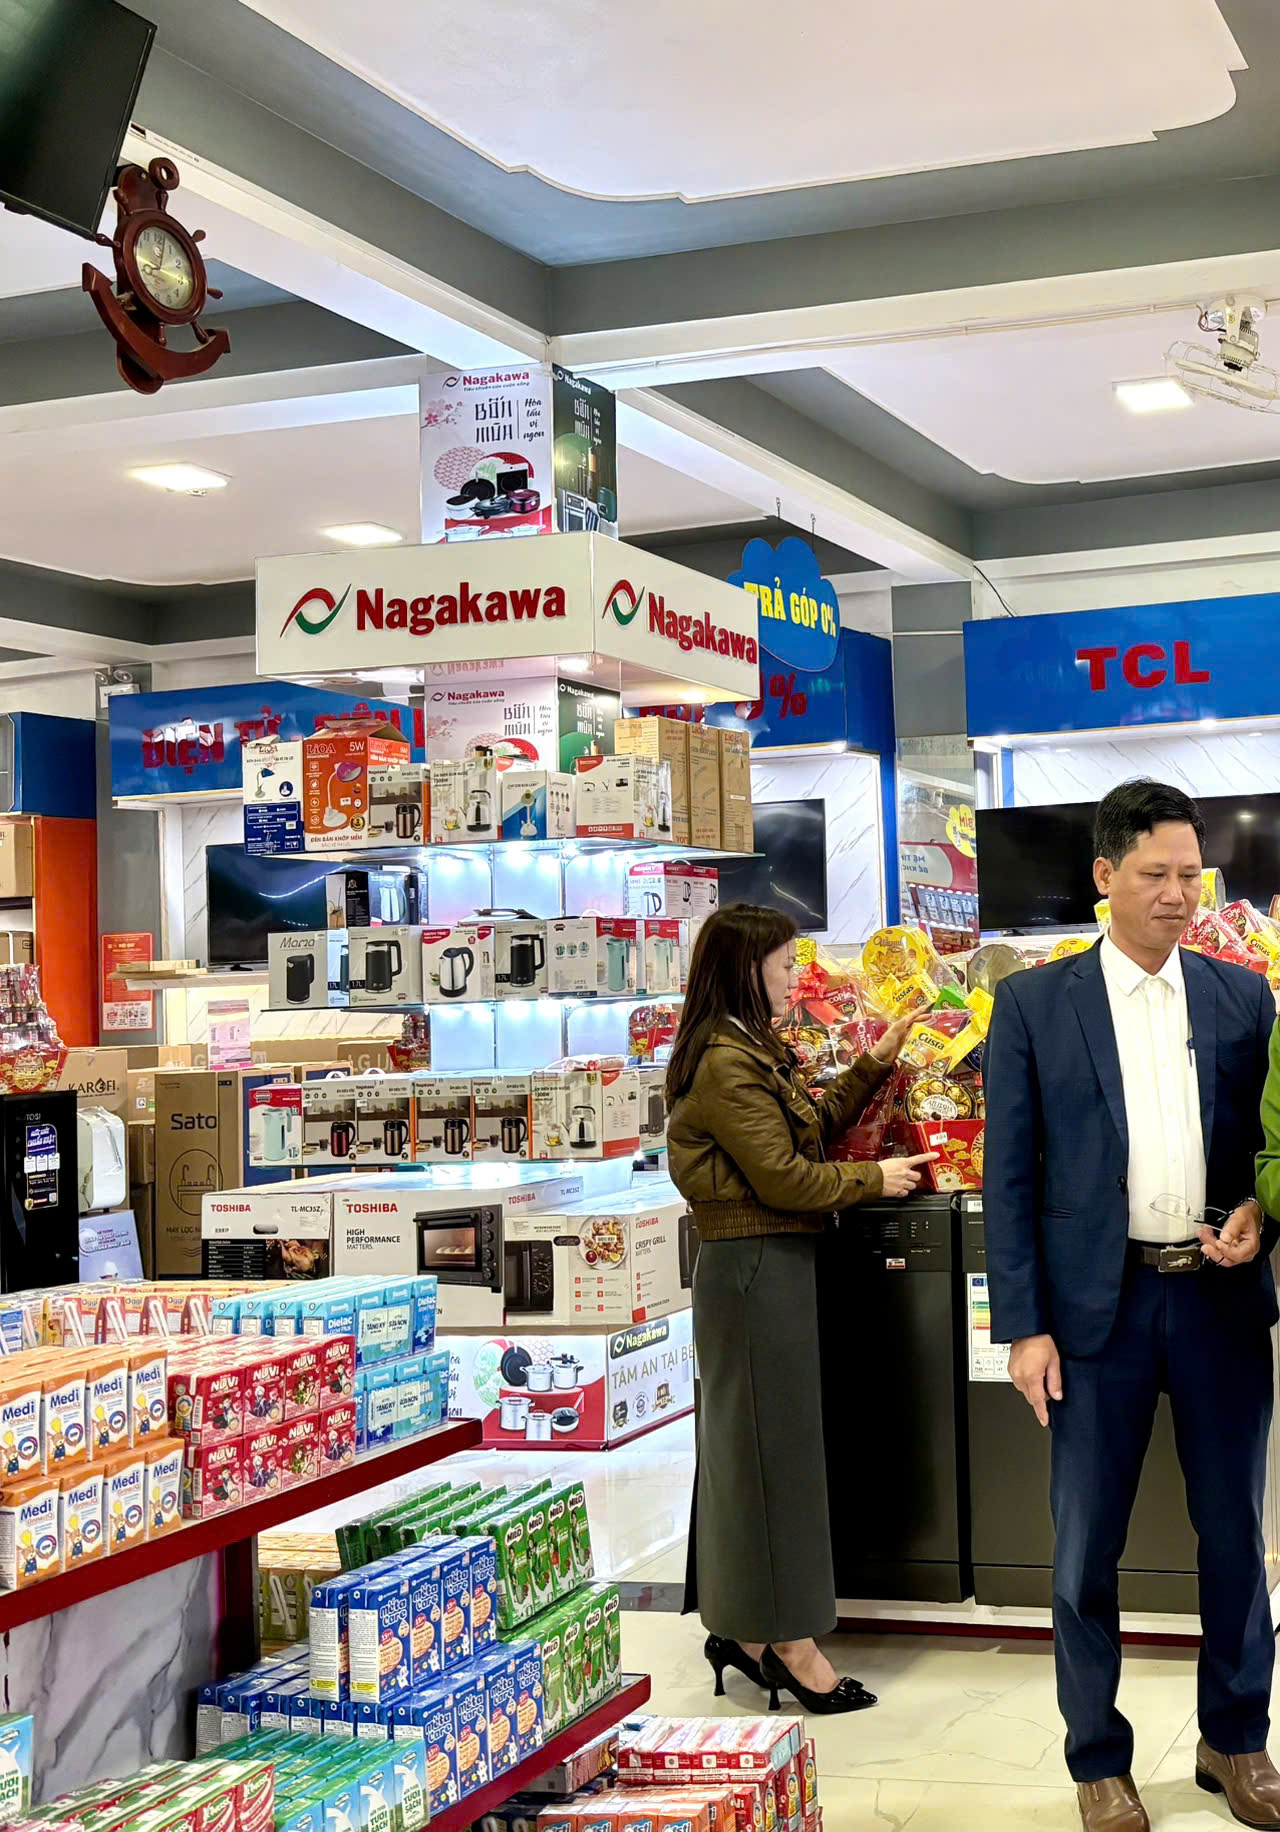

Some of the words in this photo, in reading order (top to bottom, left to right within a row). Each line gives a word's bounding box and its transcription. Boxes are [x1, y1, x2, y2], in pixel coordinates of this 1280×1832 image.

[463, 371, 530, 387] Nagakawa
[356, 581, 566, 635] Nagakawa
[790, 587, 818, 629] GÓP
[648, 592, 758, 665] Nagakawa
[1077, 641, 1209, 690] TCL
[447, 689, 505, 701] Nagakawa
[349, 741, 365, 752] 5W
[917, 1031, 945, 1051] Custa
[171, 1113, 217, 1131] Sato
[508, 1192, 537, 1206] TOSHIBA
[211, 1204, 252, 1213] TOSHIBA
[346, 1203, 398, 1213] TOSHIBA
[635, 1216, 659, 1229] TOSHIBA
[346, 1235, 401, 1244] PERFORMANCE
[635, 1238, 652, 1250] CRISPY
[652, 1235, 667, 1246] GRILL
[417, 1295, 437, 1307] Dielac
[328, 1316, 353, 1329] Dielac
[626, 1325, 667, 1349] Nagakawa
[135, 1367, 161, 1384] Medi
[611, 1365, 638, 1390] TÂM
[640, 1357, 658, 1379] AN
[660, 1349, 678, 1372] TẠI
[94, 1377, 122, 1396] Medi
[50, 1389, 79, 1408] Medi
[2, 1401, 35, 1424] Medi
[153, 1459, 178, 1477] Medi
[111, 1471, 139, 1490] Medi
[68, 1485, 97, 1505] Medi
[568, 1494, 583, 1507] MILO
[20, 1499, 52, 1521] Medi
[549, 1504, 564, 1518] MILO
[528, 1515, 543, 1530] MILO
[506, 1526, 522, 1544] MILO
[475, 1566, 495, 1583] care
[446, 1579, 468, 1597] care
[416, 1594, 439, 1611] care
[605, 1599, 618, 1613] MILO
[383, 1609, 408, 1627] care
[586, 1613, 600, 1627] MILO
[565, 1628, 578, 1642] MILO
[543, 1641, 559, 1656] MILO
[519, 1672, 541, 1690] care
[493, 1688, 515, 1707] care
[461, 1705, 484, 1725] care
[428, 1723, 453, 1744] care
[0, 1776, 19, 1791] ƯƠI
[0, 1787, 19, 1804] ẠCH
[403, 1789, 421, 1805] TƯƠI
